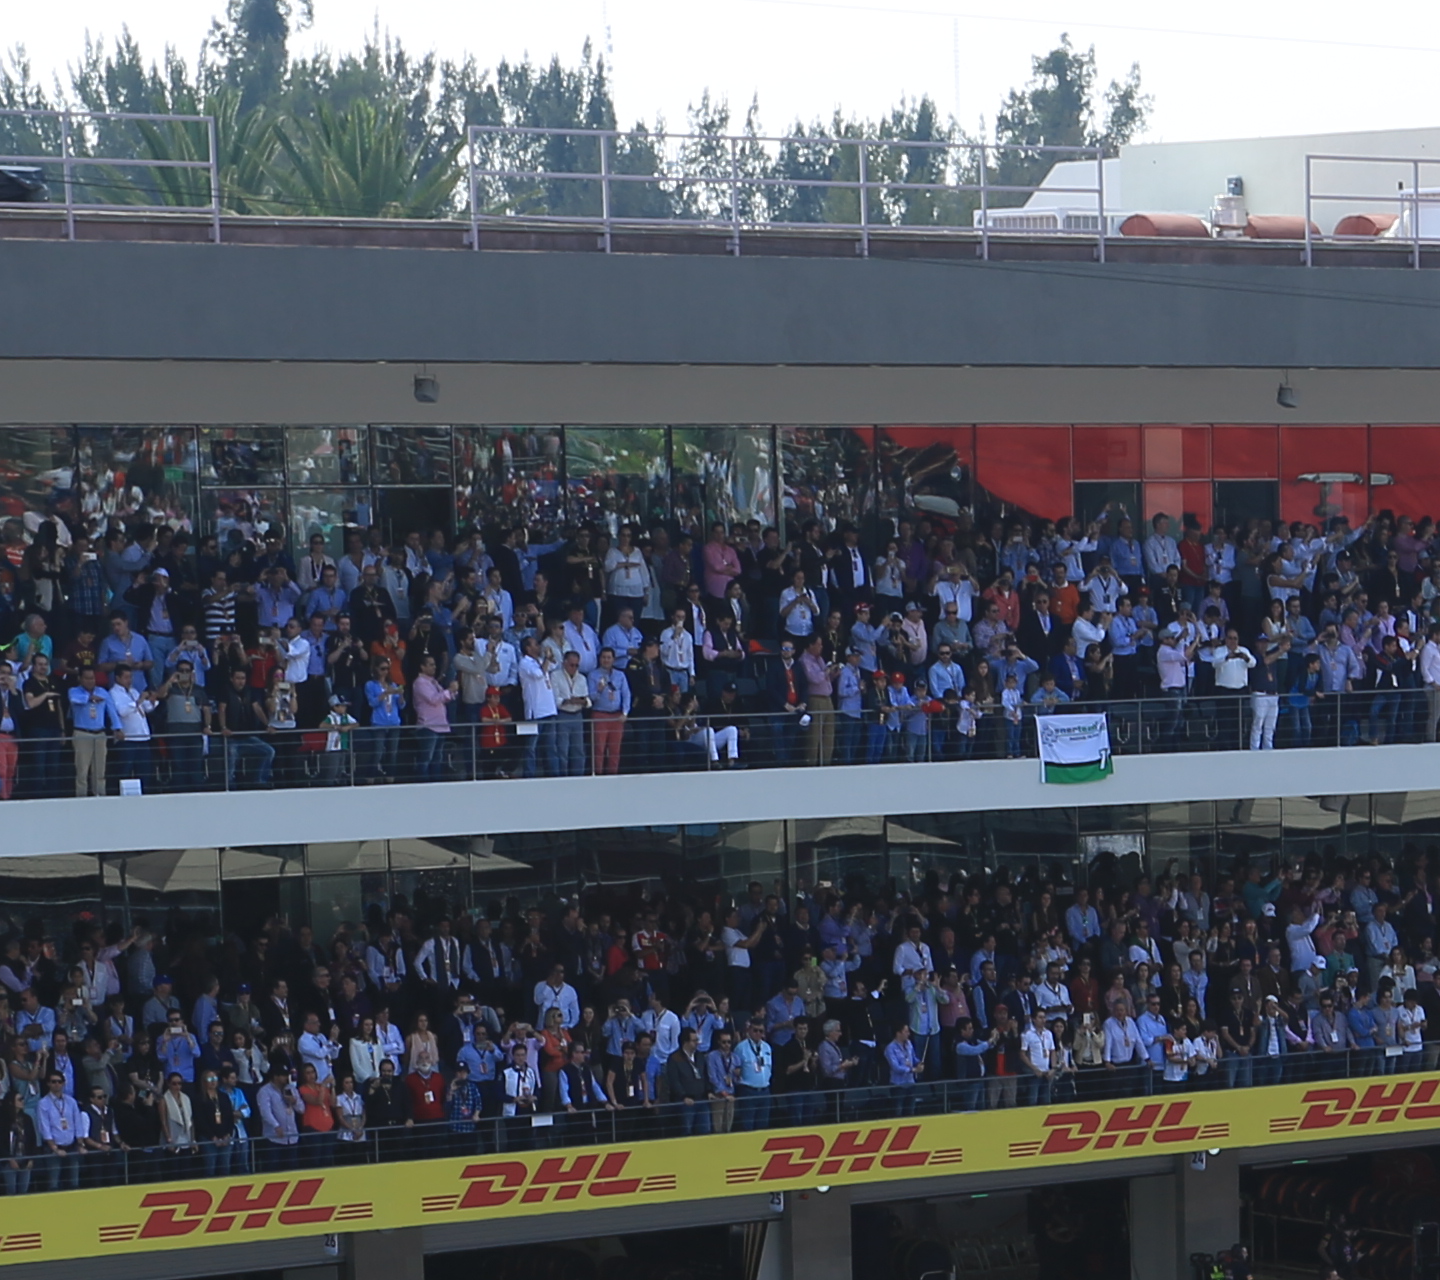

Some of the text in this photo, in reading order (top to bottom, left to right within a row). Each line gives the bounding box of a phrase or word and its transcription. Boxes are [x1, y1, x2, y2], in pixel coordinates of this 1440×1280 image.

[760, 1125, 931, 1181] DHL
[1041, 1101, 1200, 1155] DHL
[459, 1151, 642, 1209] DHL
[1191, 1152, 1204, 1166] 24
[139, 1178, 336, 1239] DHL
[769, 1192, 782, 1207] 25
[323, 1234, 337, 1253] 26
